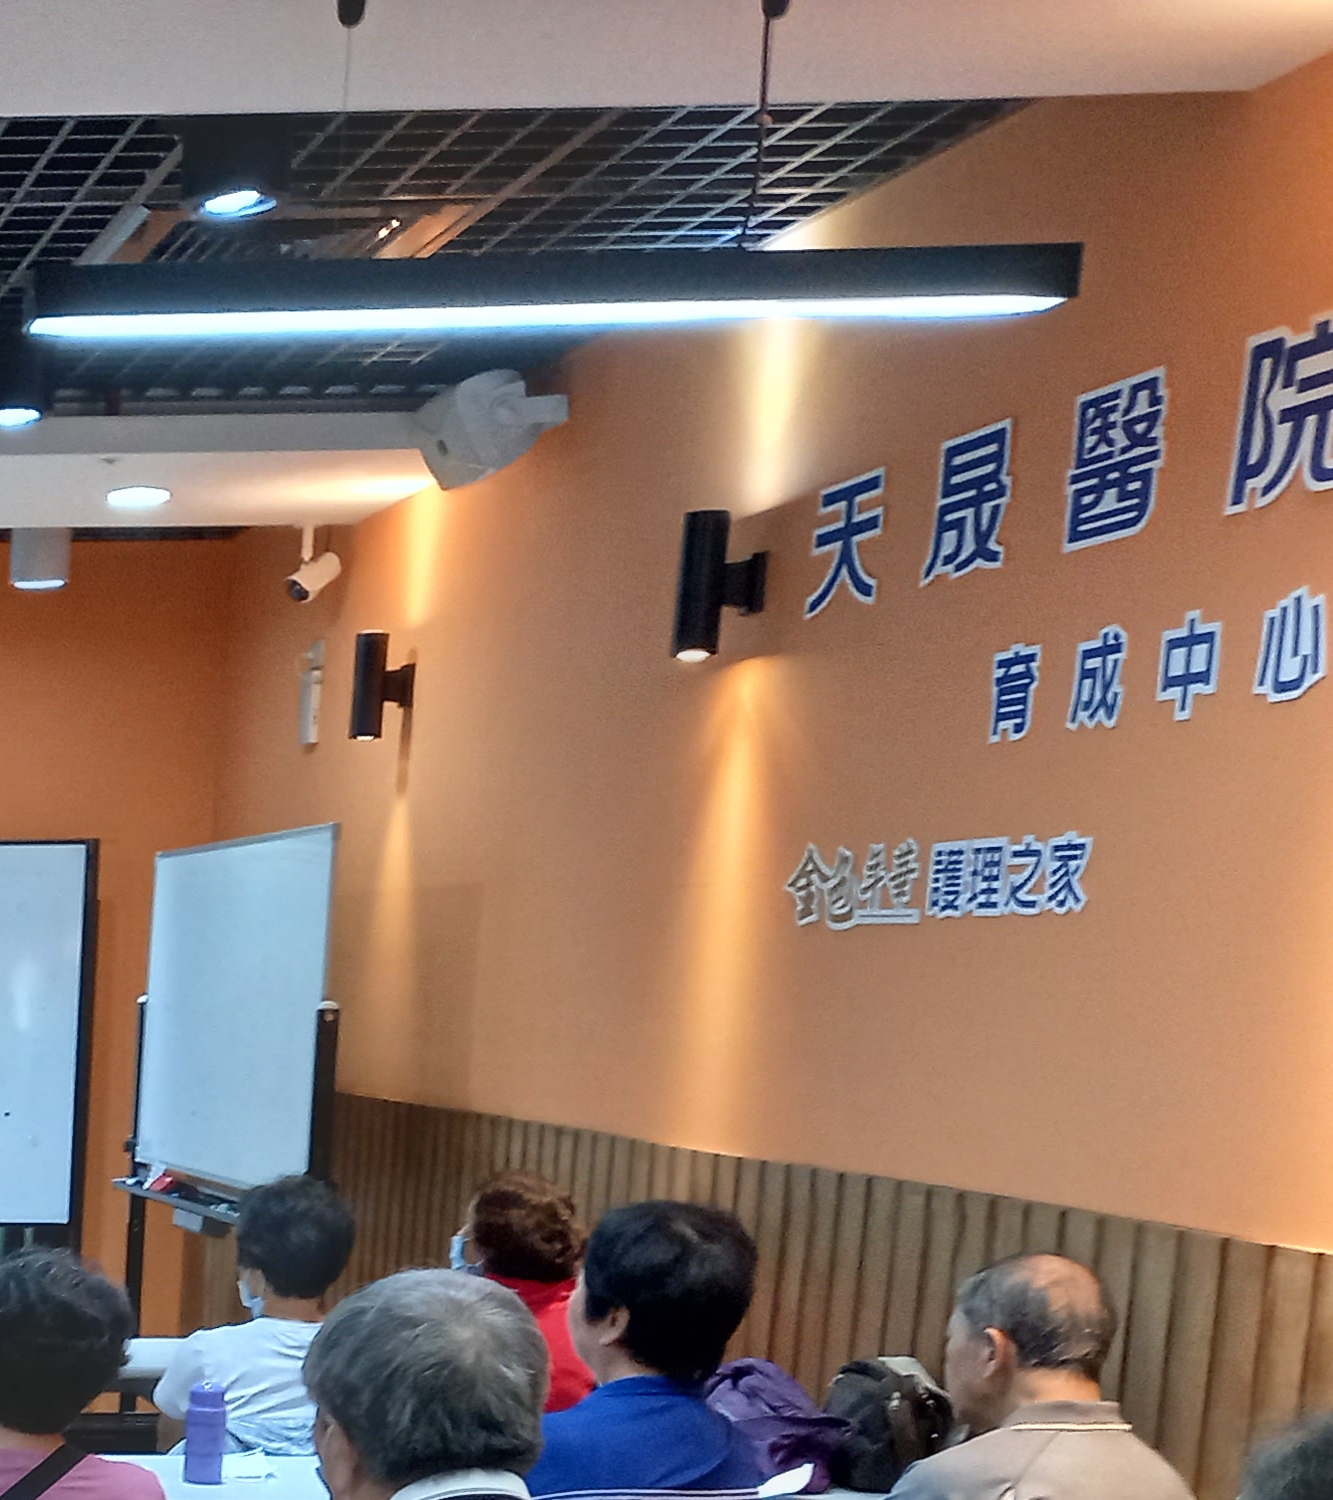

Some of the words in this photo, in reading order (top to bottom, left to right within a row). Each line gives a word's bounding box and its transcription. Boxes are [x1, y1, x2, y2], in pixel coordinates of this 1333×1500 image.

[987, 586, 1327, 744] 育成中心
[925, 831, 1094, 918] 護理之家
